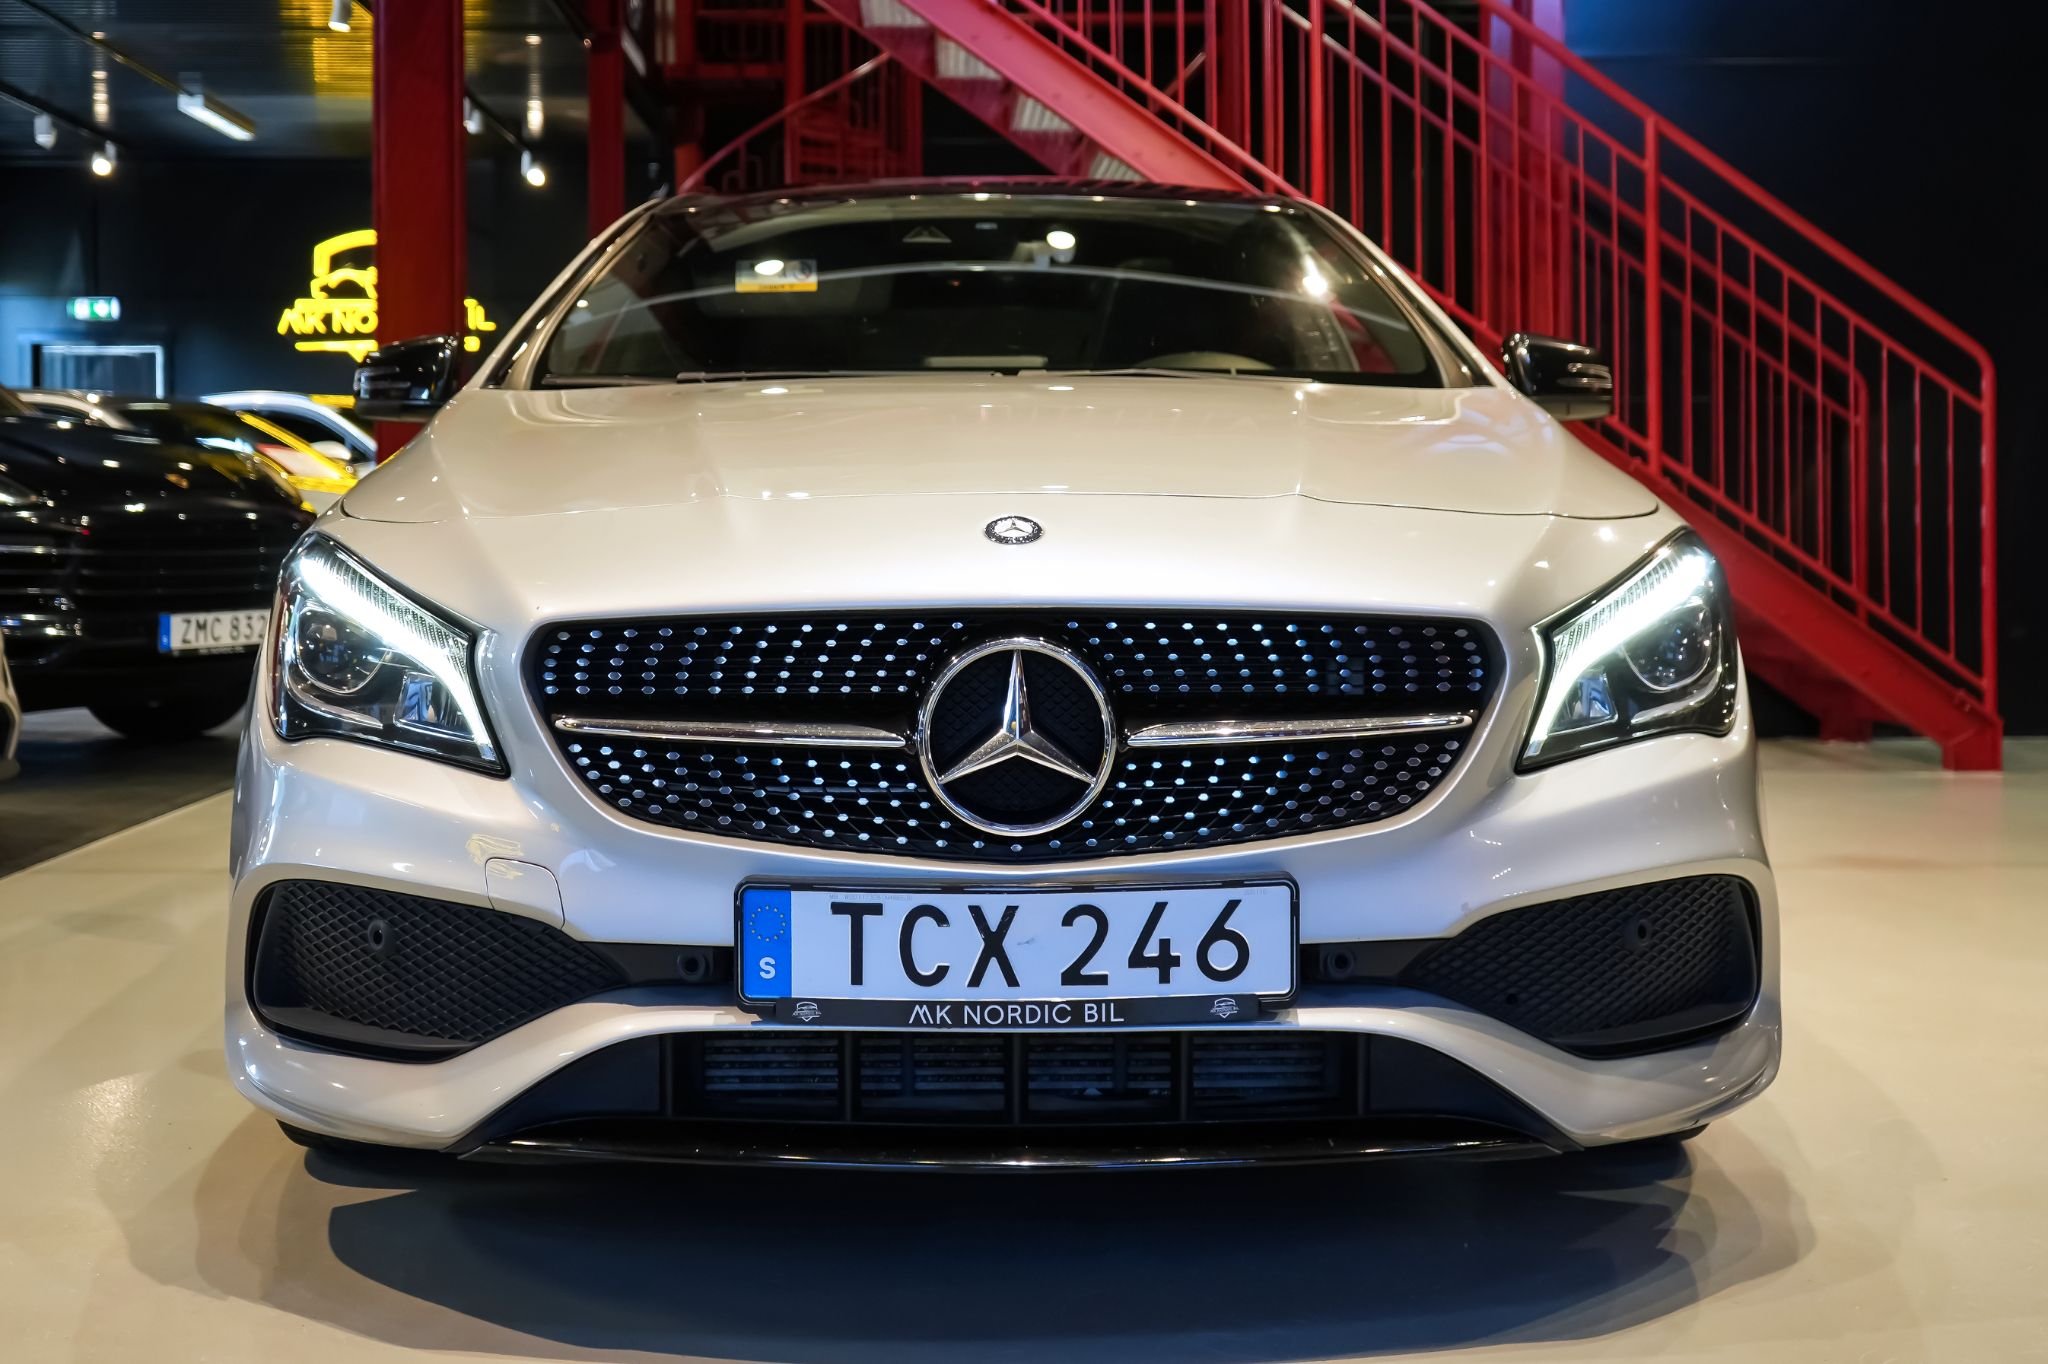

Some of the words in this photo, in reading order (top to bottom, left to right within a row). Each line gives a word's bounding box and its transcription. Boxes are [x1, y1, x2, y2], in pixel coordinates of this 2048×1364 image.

[181, 618, 222, 644] ZMC
[829, 901, 1020, 988] TCX
[1060, 898, 1250, 987] 246
[758, 956, 777, 980] S
[908, 1004, 953, 1025] MK
[963, 1003, 1072, 1025] NORDIC
[1083, 1002, 1125, 1023] BIL
